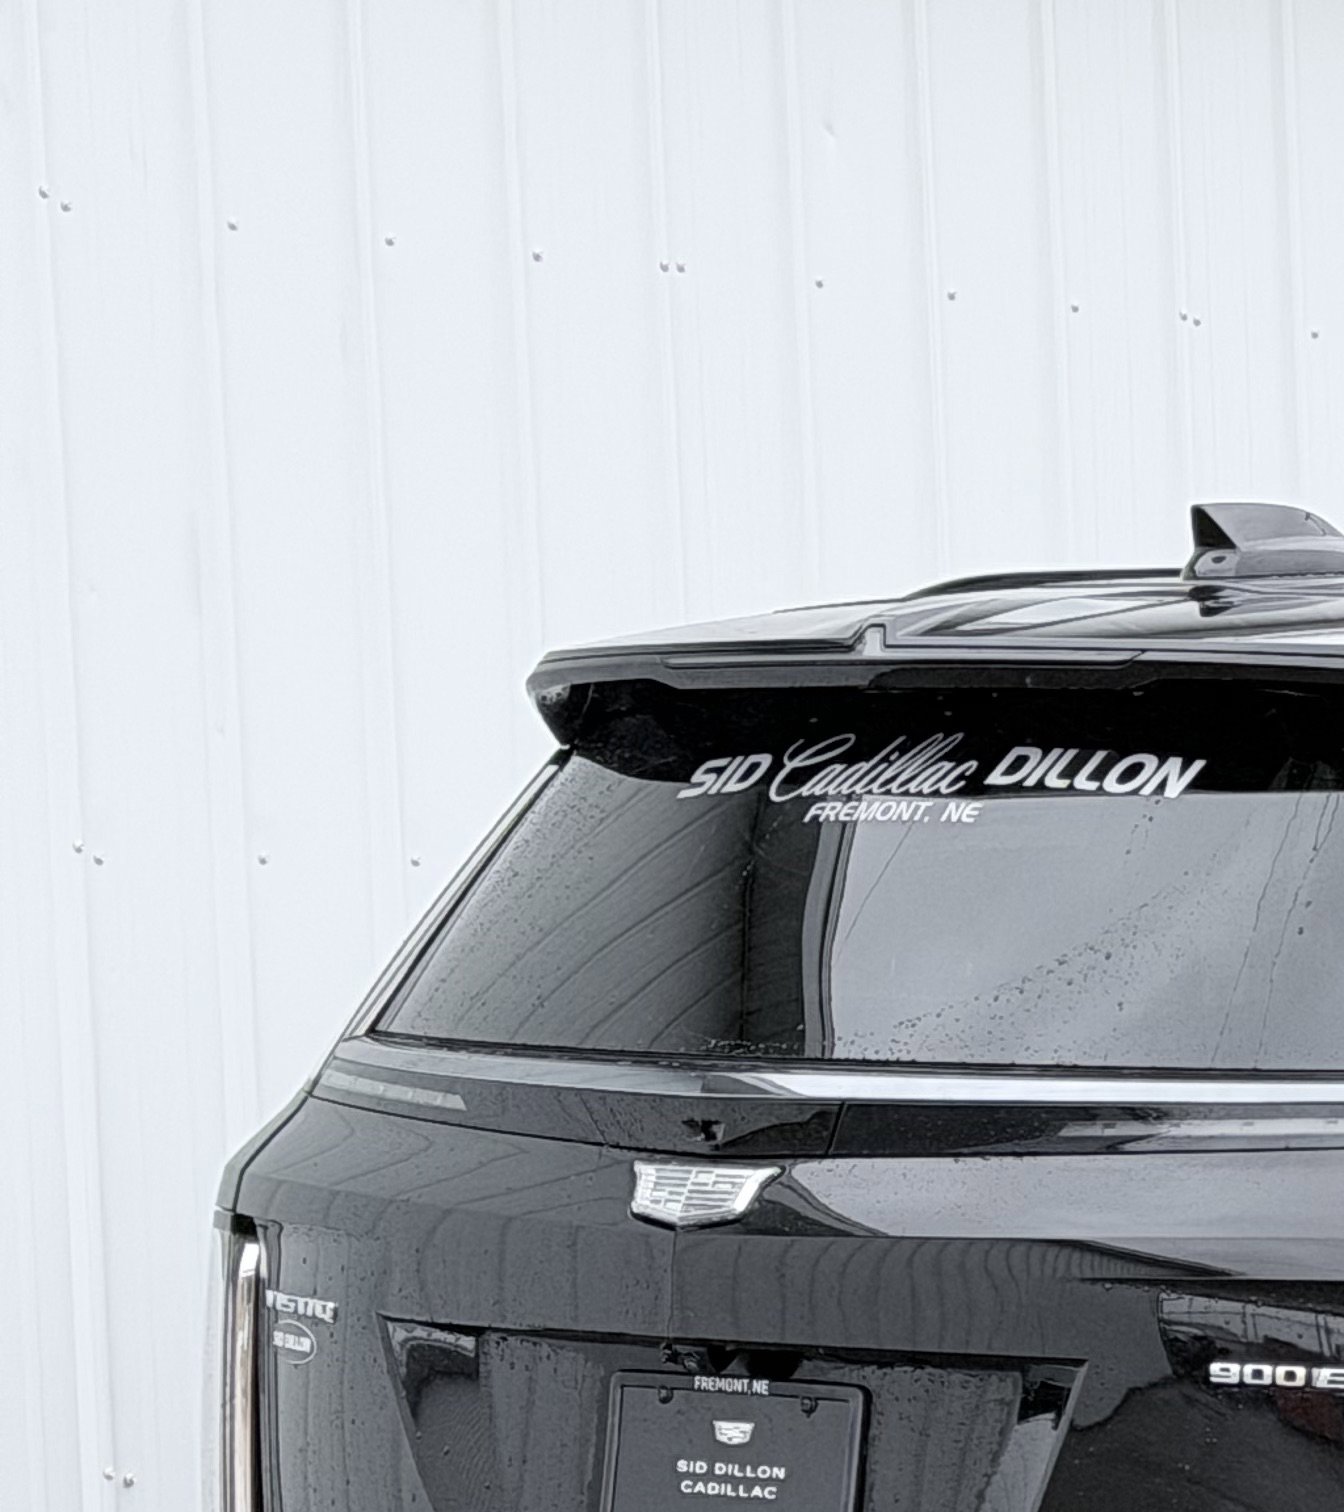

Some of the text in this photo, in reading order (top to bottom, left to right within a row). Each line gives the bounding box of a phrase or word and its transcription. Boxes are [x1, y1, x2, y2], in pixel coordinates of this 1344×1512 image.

[677, 733, 1206, 802] SID Cadillac DILLON
[940, 802, 983, 823] NE
[752, 1379, 769, 1395] NE
[676, 1460, 786, 1480] SID DILLON
[680, 1480, 778, 1500] CADILLAC
